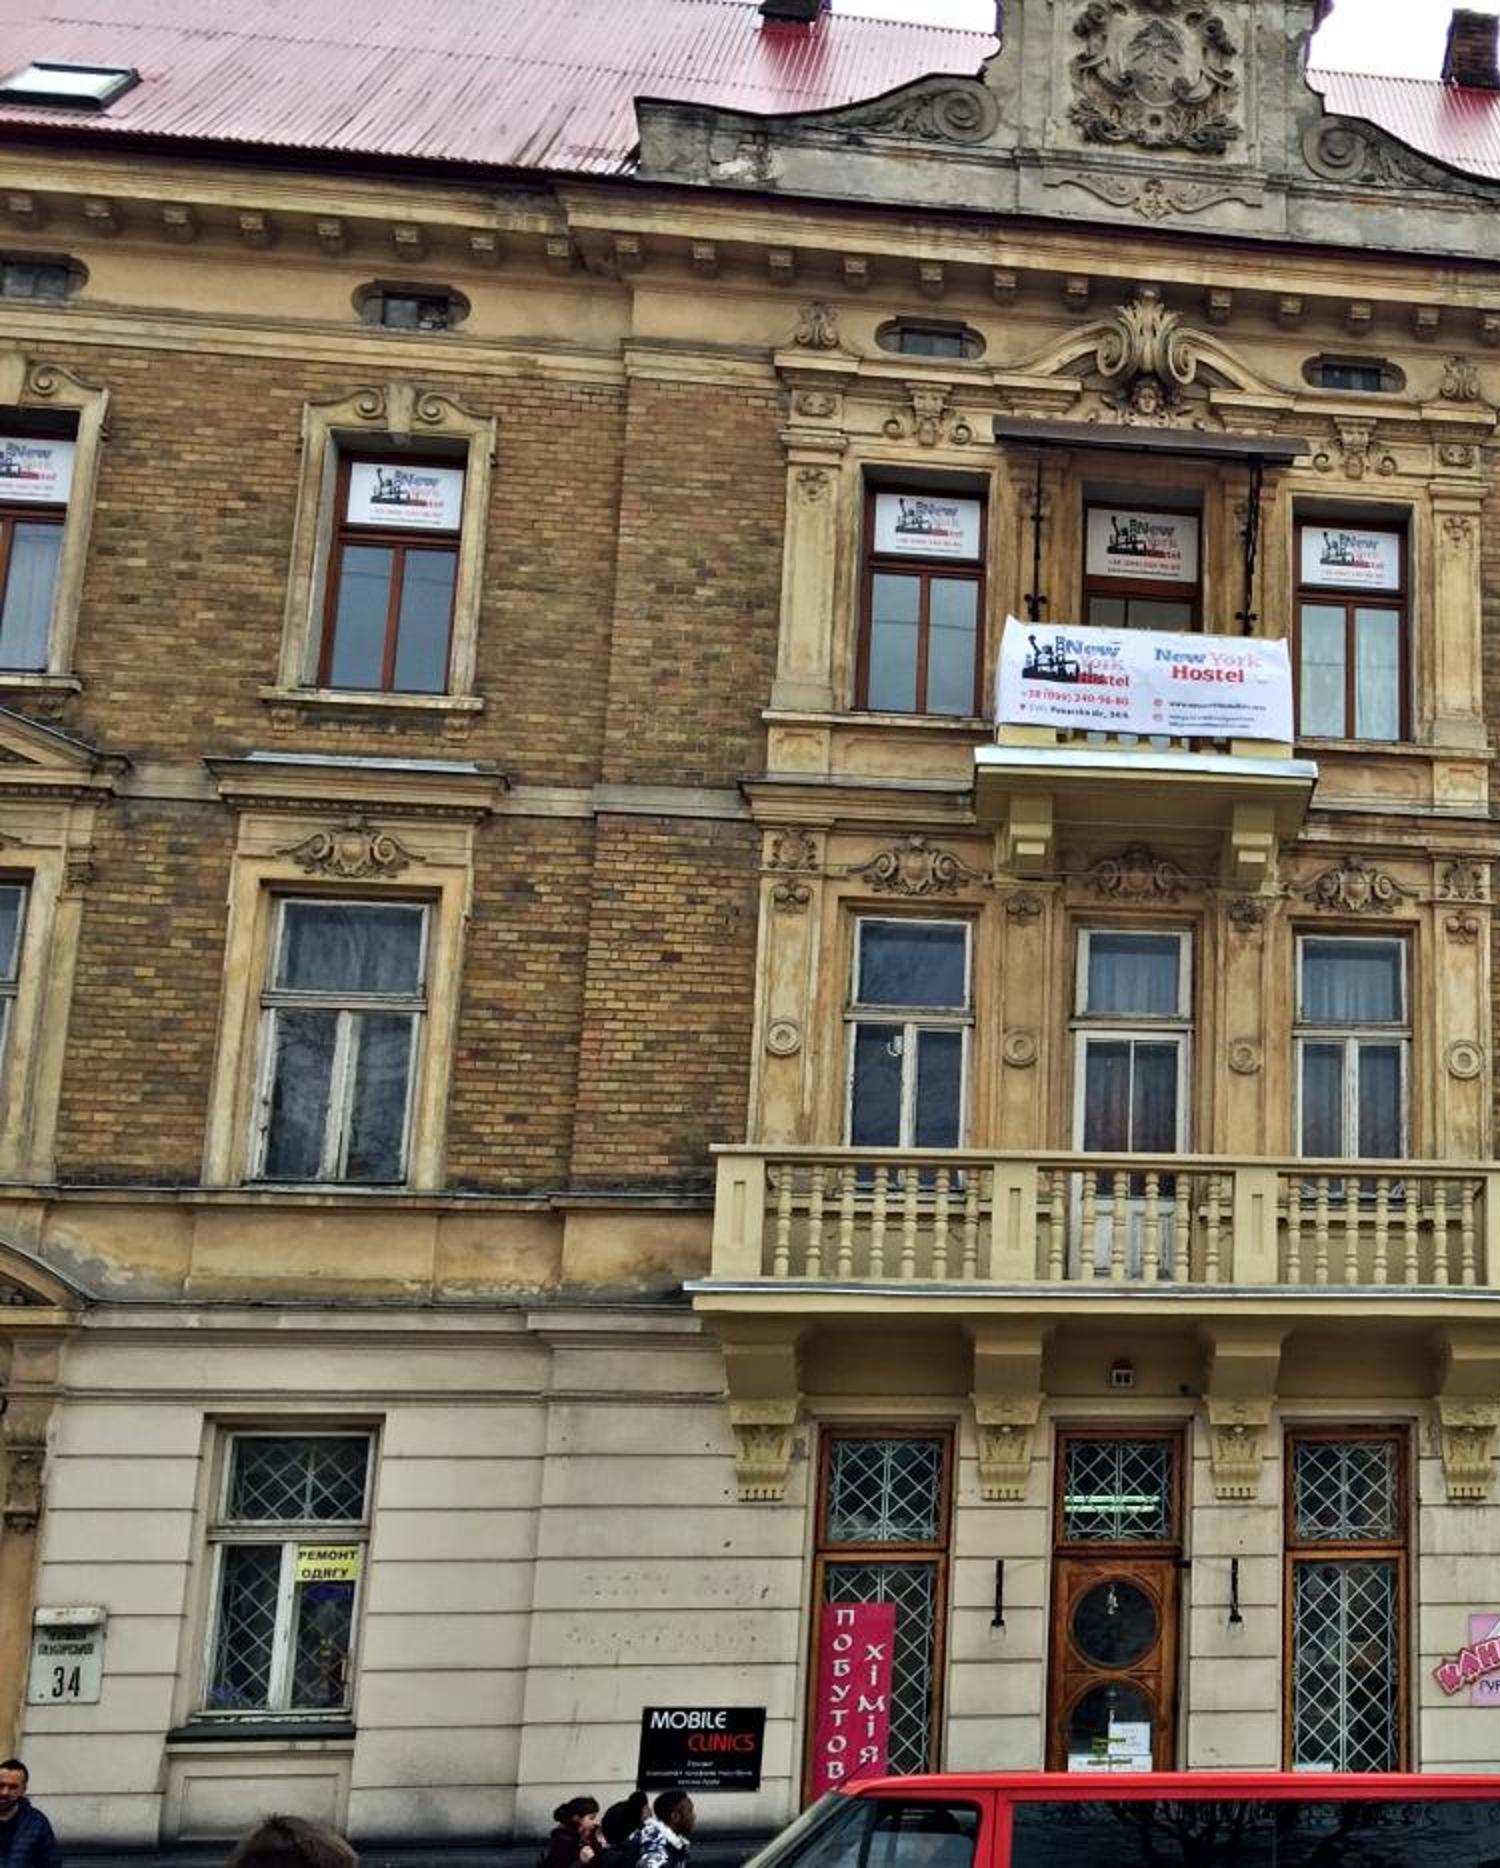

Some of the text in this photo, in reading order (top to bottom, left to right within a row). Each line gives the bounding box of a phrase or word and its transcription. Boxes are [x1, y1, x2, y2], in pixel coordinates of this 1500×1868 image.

[1065, 638, 1121, 657] New
[1154, 647, 1263, 668] New York
[1171, 665, 1245, 684] Hostel
[298, 1550, 357, 1561] РЕМОНТ
[51, 1665, 81, 1698] 34
[826, 1609, 856, 1788] ПОБУТОВ
[650, 1710, 727, 1729] MOBILE
[687, 1733, 756, 1752] CLINICS
